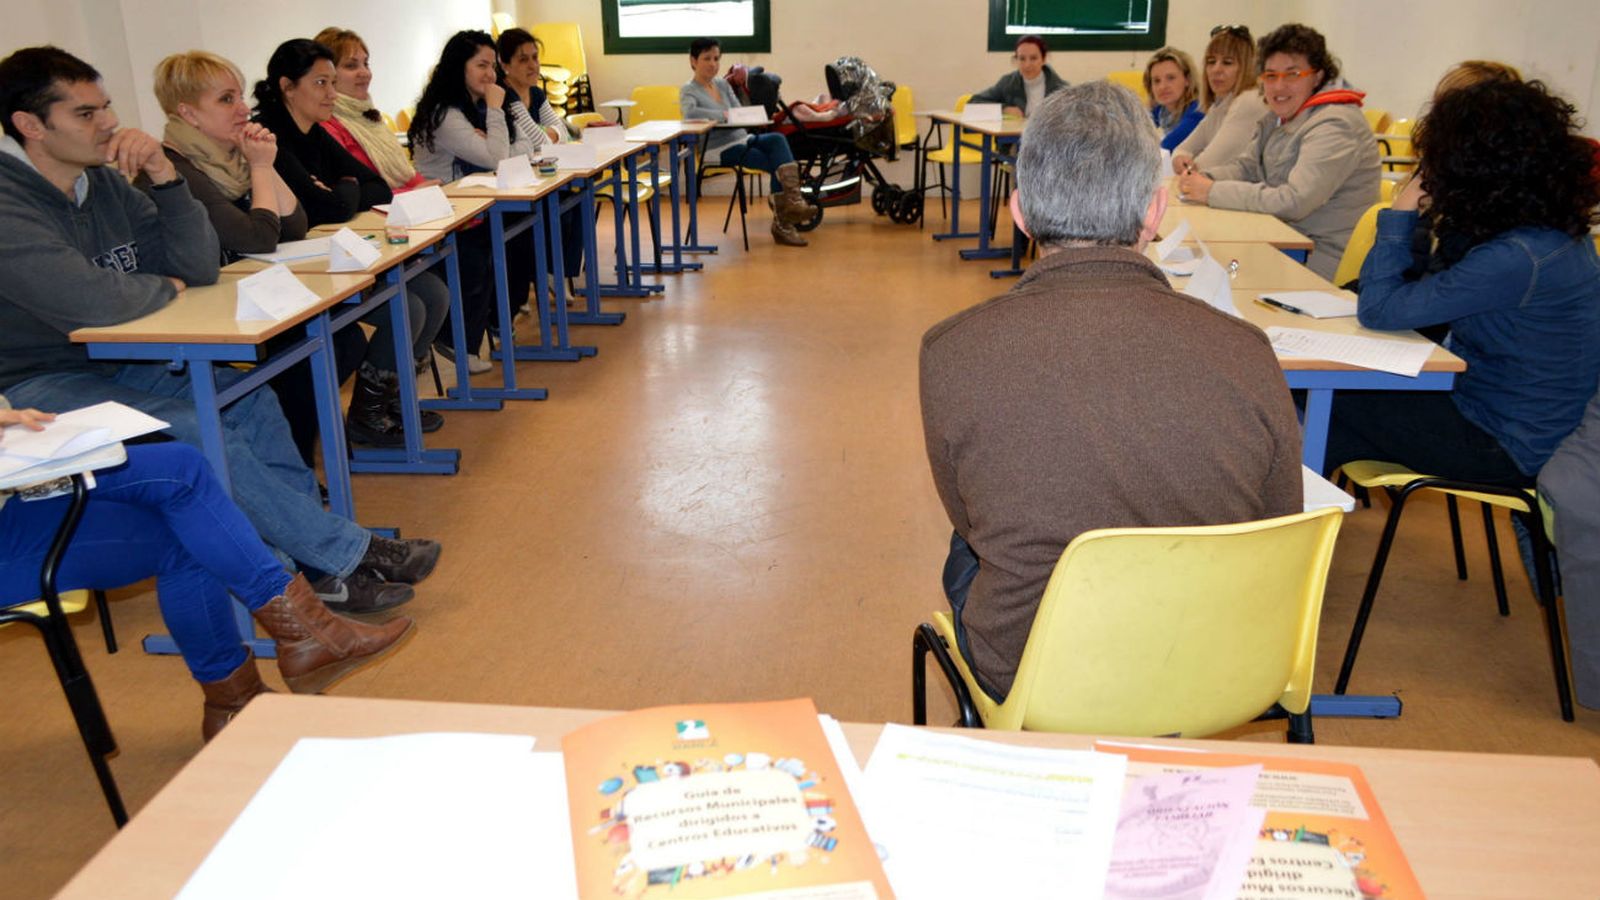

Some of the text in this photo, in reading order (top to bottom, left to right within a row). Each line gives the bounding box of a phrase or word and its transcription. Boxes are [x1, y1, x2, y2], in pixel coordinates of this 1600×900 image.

[634, 796, 797, 824] Recursos Municipales
[679, 812, 747, 828] dirigidos
[648, 823, 797, 849] Centros Educativos
[1269, 857, 1334, 869] Centros
[1278, 883, 1356, 898] Recursos
